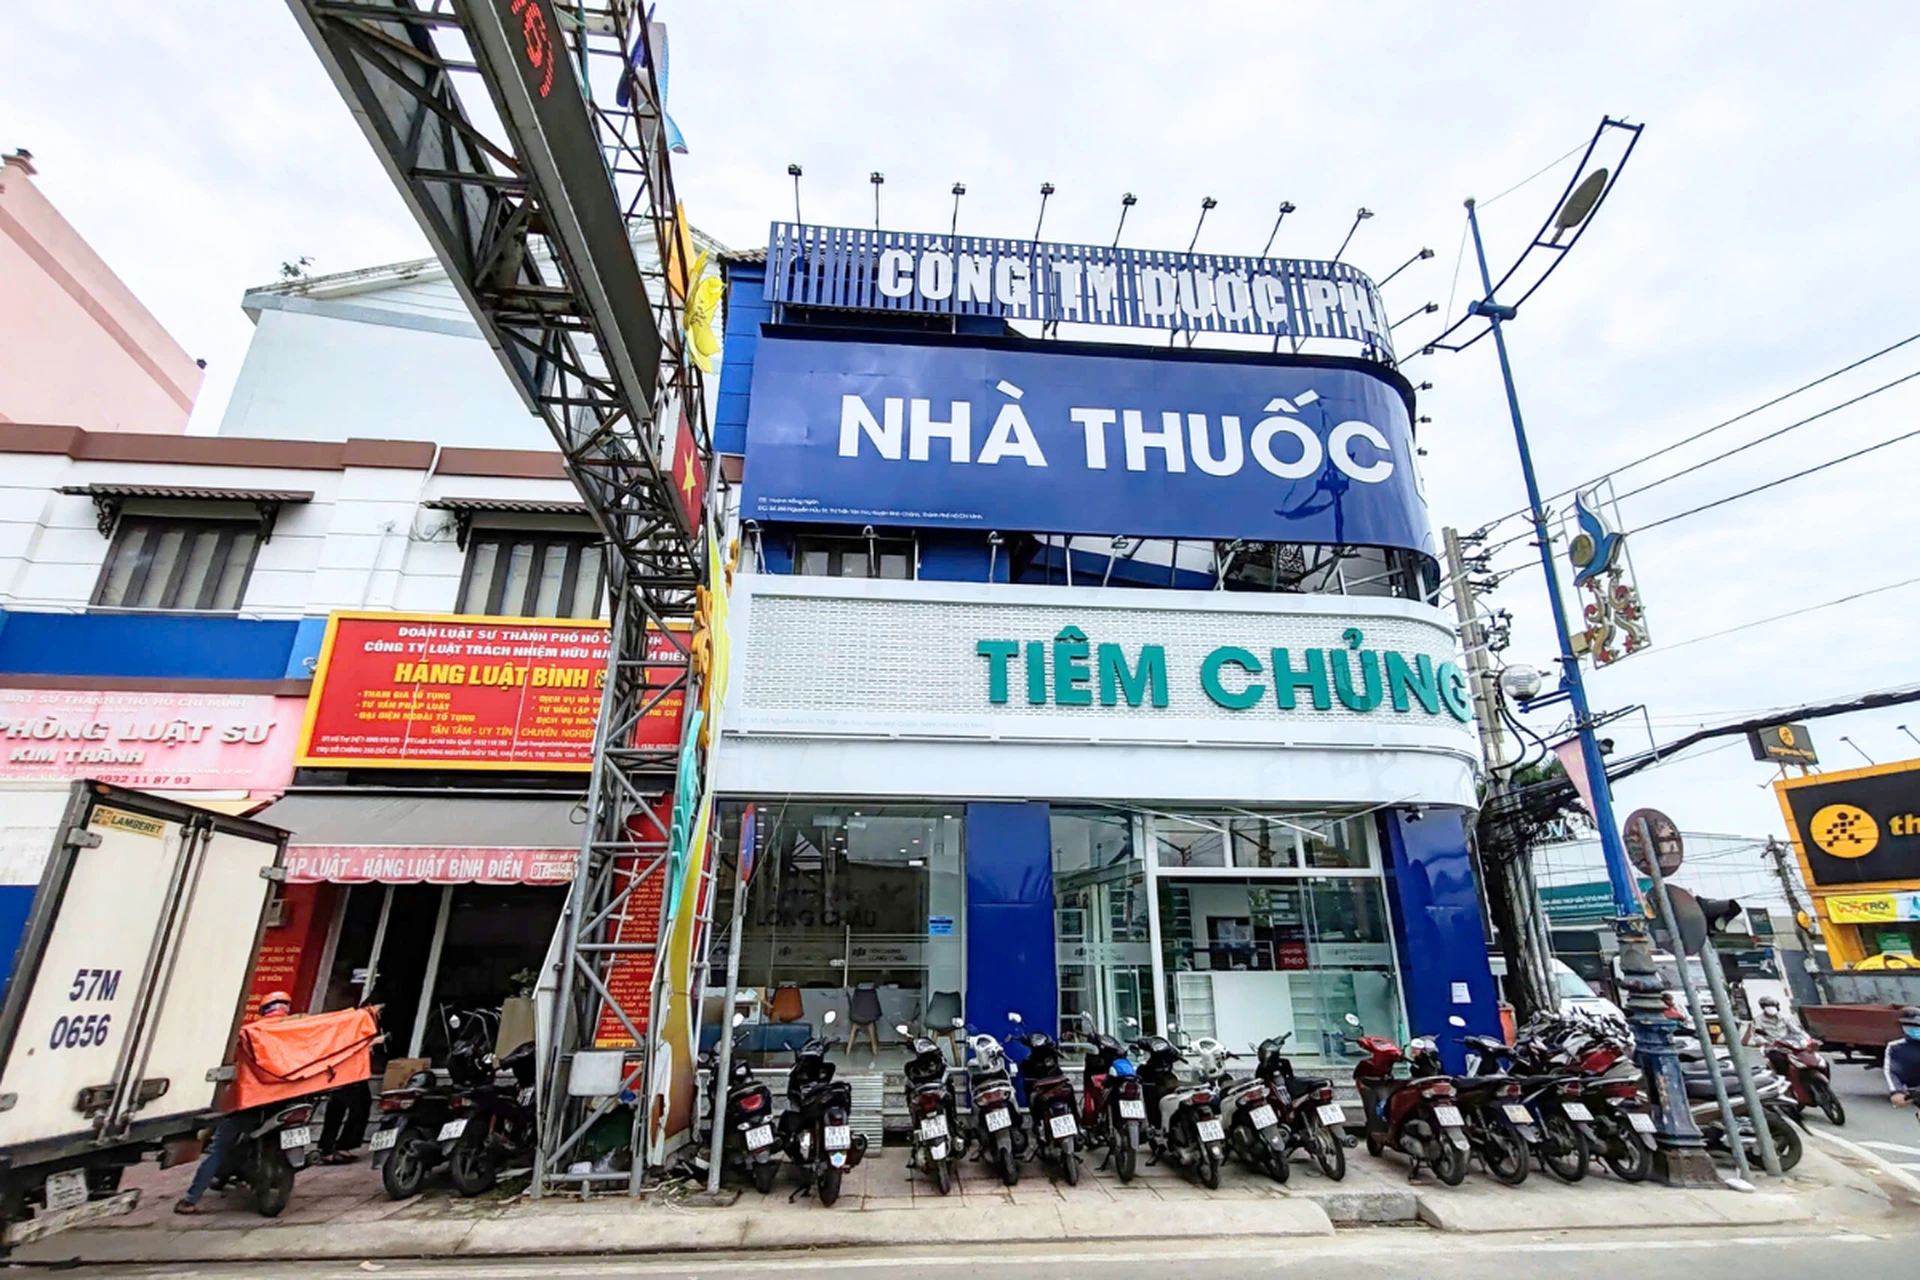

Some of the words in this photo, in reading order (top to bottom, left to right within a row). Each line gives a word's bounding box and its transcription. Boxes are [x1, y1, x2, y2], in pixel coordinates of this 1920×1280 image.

[877, 243, 1030, 305] CÔNG
[1050, 255, 1118, 311] TY
[838, 379, 1048, 468] NHÀ
[1070, 389, 1394, 483] THUỐC
[398, 626, 437, 637] ĐOÀN
[440, 627, 474, 641] LUẬT
[478, 629, 498, 640] SƯ
[502, 630, 548, 642] THÀNH
[550, 630, 578, 644] PHỐ
[581, 630, 600, 644] HỒ
[364, 640, 403, 652] CÔNG
[408, 643, 426, 652] TY
[429, 643, 463, 656] LUẬT
[466, 642, 510, 656] TRÁCH
[513, 646, 557, 660] NHIỆM
[560, 646, 588, 658] HỮU
[394, 659, 466, 684] HÃNG
[469, 661, 528, 690] LUẬT
[531, 663, 590, 689] BÌNH
[977, 625, 1169, 708] TIÊM
[1201, 627, 1475, 722] CHỦNG
[393, 691, 409, 699] GIA
[118, 720, 212, 748] LUẬT
[220, 722, 278, 745] SƯ
[479, 727, 492, 736] UY
[10, 749, 56, 764] KIM
[64, 747, 144, 765] THÀNH
[133, 775, 149, 785] 11
[153, 775, 170, 785] 87
[174, 776, 191, 785] 93
[110, 813, 164, 836] LAMBERET
[310, 852, 350, 877] LUẬT
[363, 853, 404, 877] HÃNG
[407, 854, 446, 878] LUẬT
[448, 855, 484, 879] BÌNH
[487, 851, 523, 879] ĐIỀN
[69, 969, 121, 1001] 57M
[49, 1014, 111, 1050] 0656
